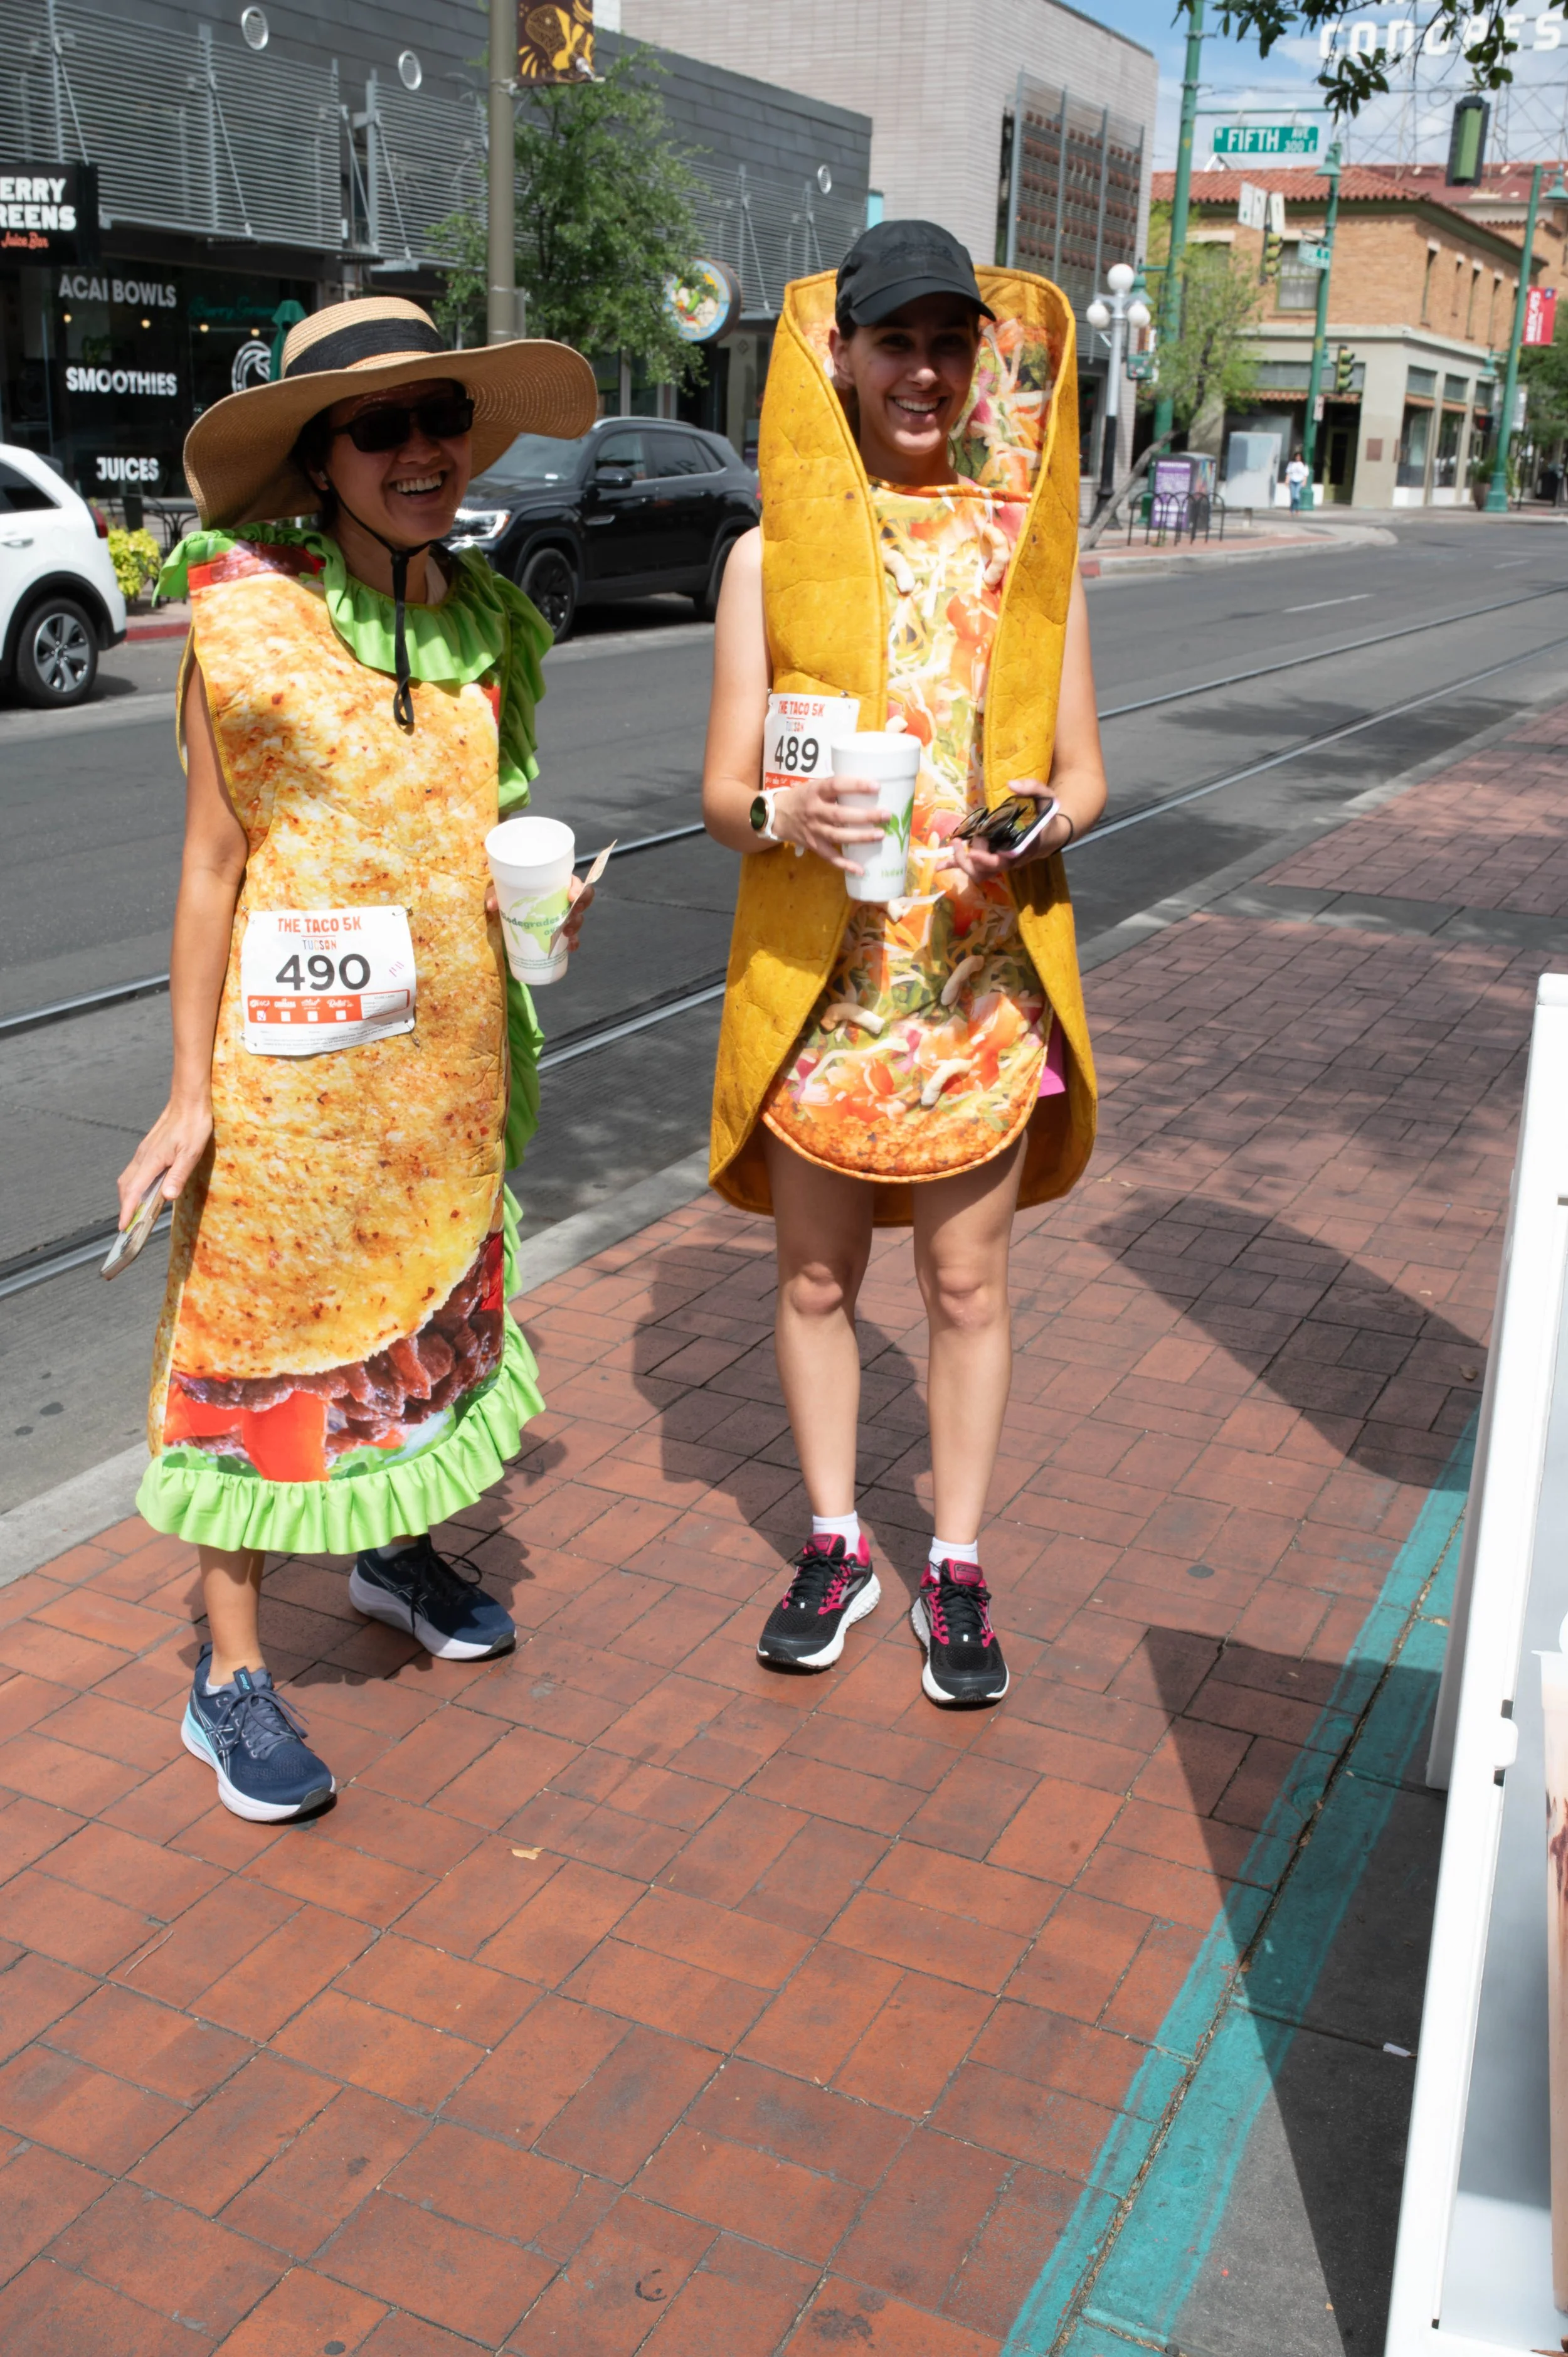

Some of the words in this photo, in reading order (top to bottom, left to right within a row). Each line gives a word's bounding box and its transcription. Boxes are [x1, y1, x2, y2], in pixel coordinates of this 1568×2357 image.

[1227, 129, 1279, 152] FIFTH
[1291, 127, 1310, 139] AVE
[0, 176, 66, 203] ERRY
[58, 274, 109, 302] ACAI
[112, 279, 177, 308] BOWLS
[66, 366, 177, 396] SMOOTHIES
[96, 457, 159, 481] JUICES
[778, 700, 788, 715] THE
[790, 701, 810, 716] TACO
[812, 703, 825, 717] 5K
[775, 735, 819, 773] 489
[278, 918, 301, 934] THE
[304, 918, 339, 934] TACO
[342, 916, 362, 931] 5K
[302, 940, 337, 950] TUCSON
[275, 953, 371, 991] 490
